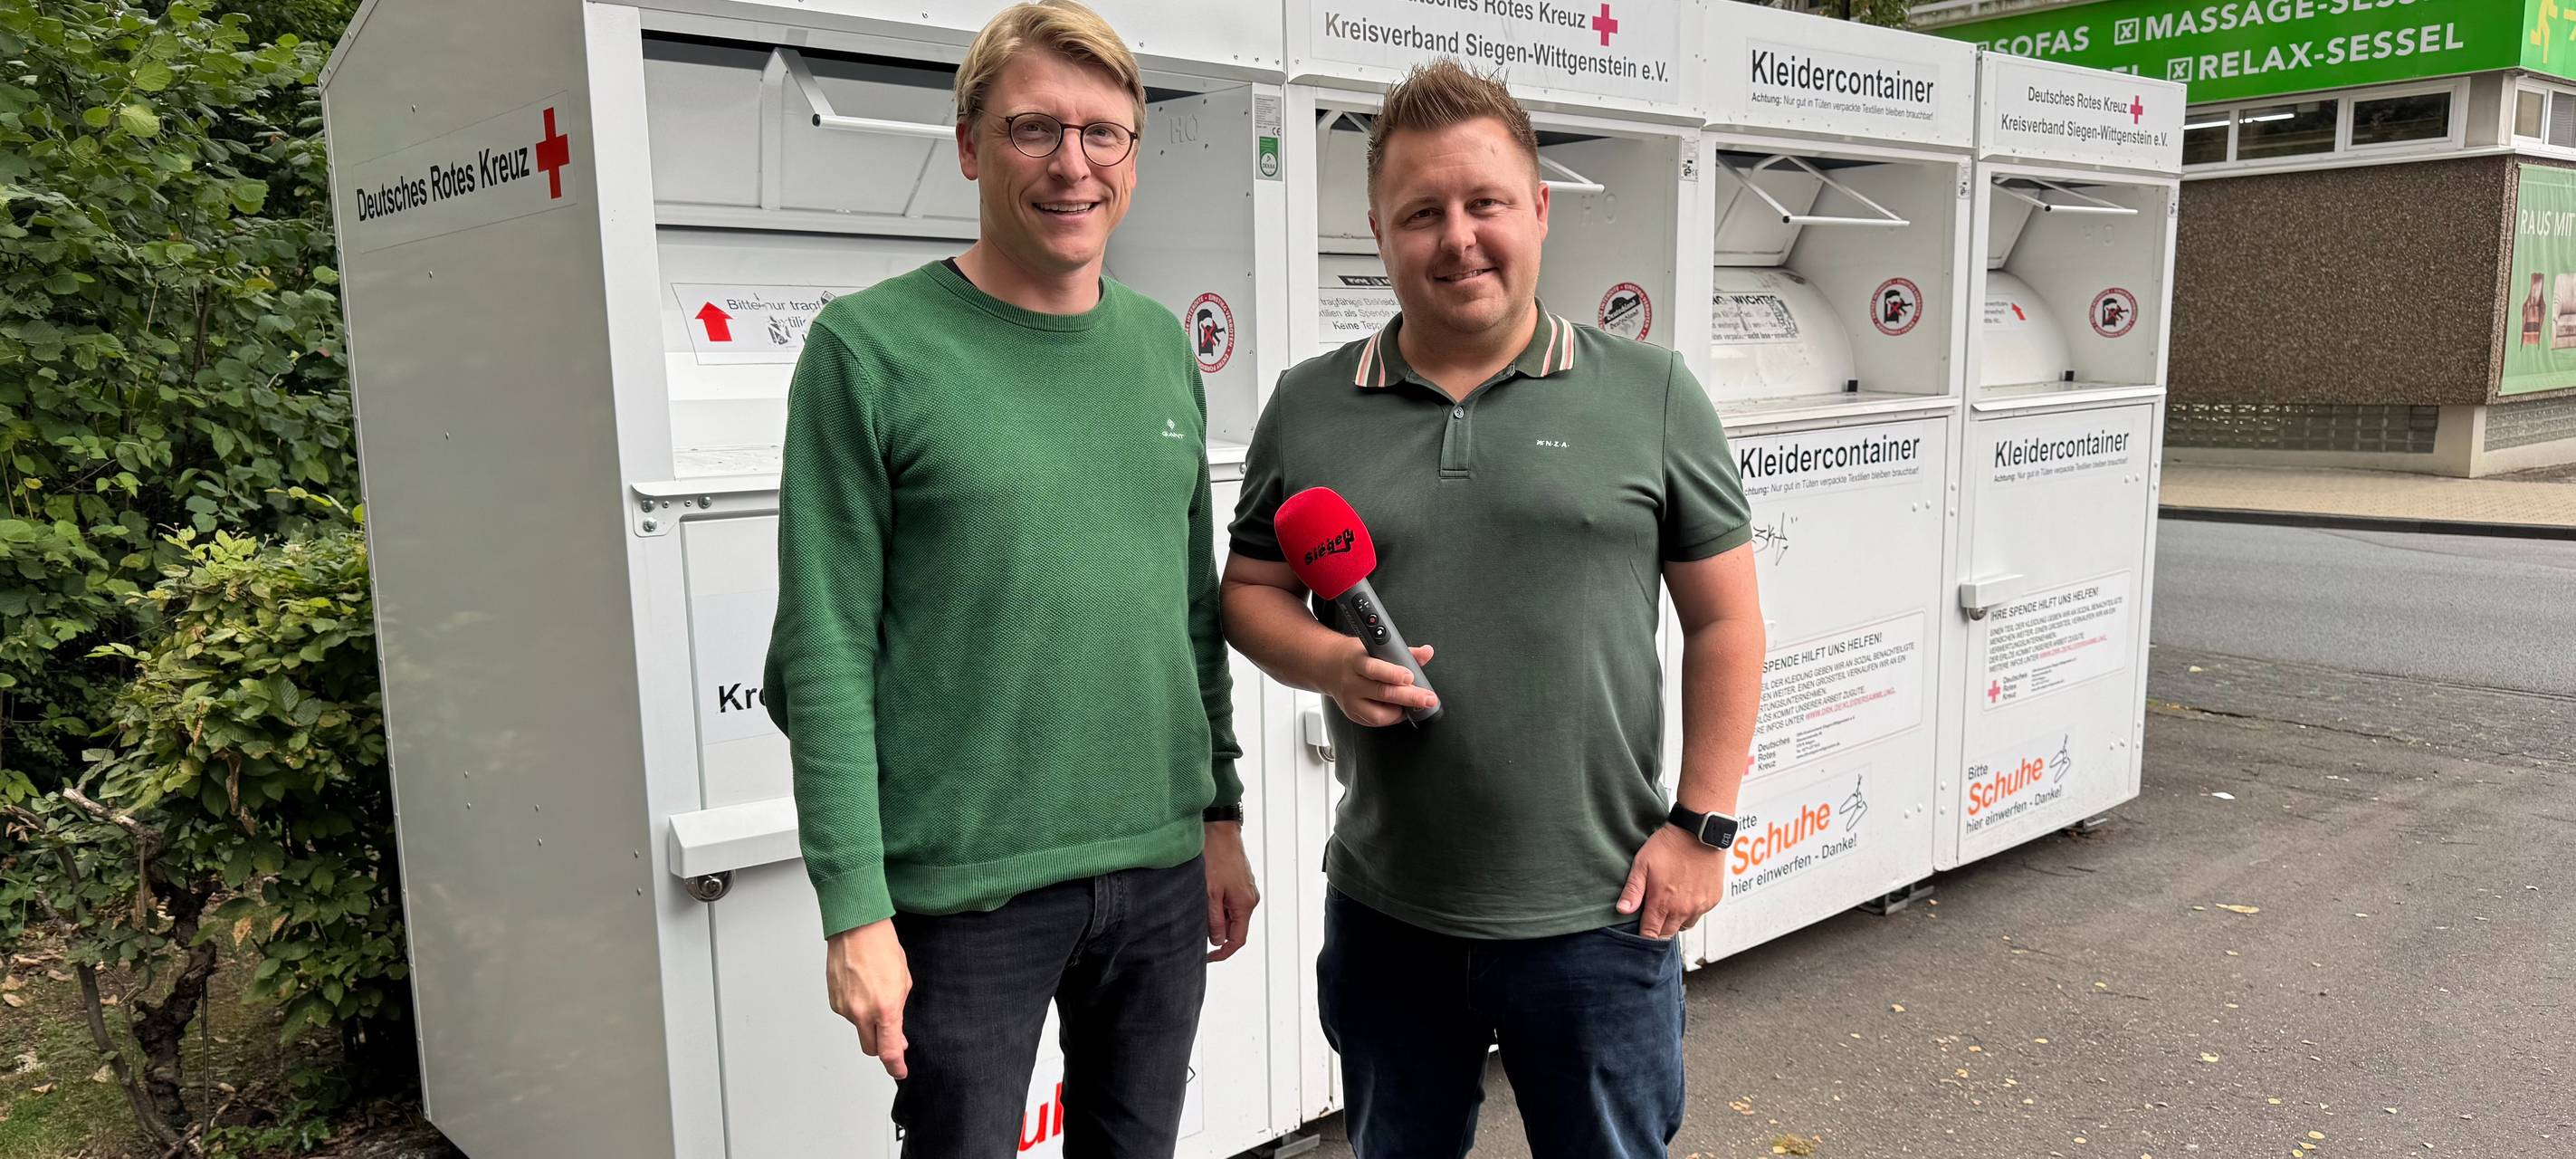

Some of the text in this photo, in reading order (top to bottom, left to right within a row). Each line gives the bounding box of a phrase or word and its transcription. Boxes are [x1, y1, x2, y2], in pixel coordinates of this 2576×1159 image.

[1484, 0, 1533, 20] Rotes
[1539, 2, 1585, 28] Kreuz
[1325, 12, 1668, 82] Kreisverband Siegen-Wittgenstein e.V.
[1994, 26, 2090, 57] SOFAS
[2199, 23, 2464, 81] RELAX-SESSEL
[1751, 50, 1933, 103] Kleidercontainer
[1751, 92, 1781, 104] Achtung:
[1783, 96, 1794, 105] Nur
[1796, 98, 1806, 108] gut
[1808, 99, 1813, 107] in
[1815, 99, 1831, 110] Tüten
[1833, 101, 1861, 112] verpackte
[2028, 86, 2127, 114] Deutsches Rotes Kreuz
[2001, 114, 2168, 147] Kreisverband Siegen-Wittgenstein e.V.
[357, 148, 530, 221] Deutsches Rotes Kreuz
[2520, 209, 2576, 236] RAUS MIT
[727, 299, 759, 310] Bitte
[1332, 321, 1360, 330] Keine
[1741, 435, 1920, 479] Kleidercontainer
[1995, 429, 2129, 467] Kleidercontainer
[1745, 484, 1770, 496] chtung:
[1771, 484, 1782, 493] Nur
[1783, 482, 1794, 493] gut
[1795, 482, 1800, 490] in
[1802, 479, 1818, 490] Tüten
[1820, 476, 1847, 488] verpackte
[1990, 587, 2099, 622] IHRE SPENDE HILFT UNS HELFEN!
[1763, 632, 1883, 674] SPENDE HILFT UNS HELFEN!
[1758, 737, 1789, 752] Deutsches
[1758, 752, 1776, 761] Rotes
[1758, 761, 1776, 771] Kreuz
[1968, 764, 1989, 780] Bitte
[1968, 758, 2043, 815] Schuhe
[1739, 814, 1757, 830] itte
[1966, 819, 1982, 833] hier
[1985, 801, 2027, 826] einwerfen
[2035, 785, 2062, 806] Danke!
[1732, 802, 1830, 876] Schuhe
[1731, 876, 1753, 896] hier
[1757, 855, 1811, 886] einwerfen
[1822, 833, 1857, 859] Danke!
